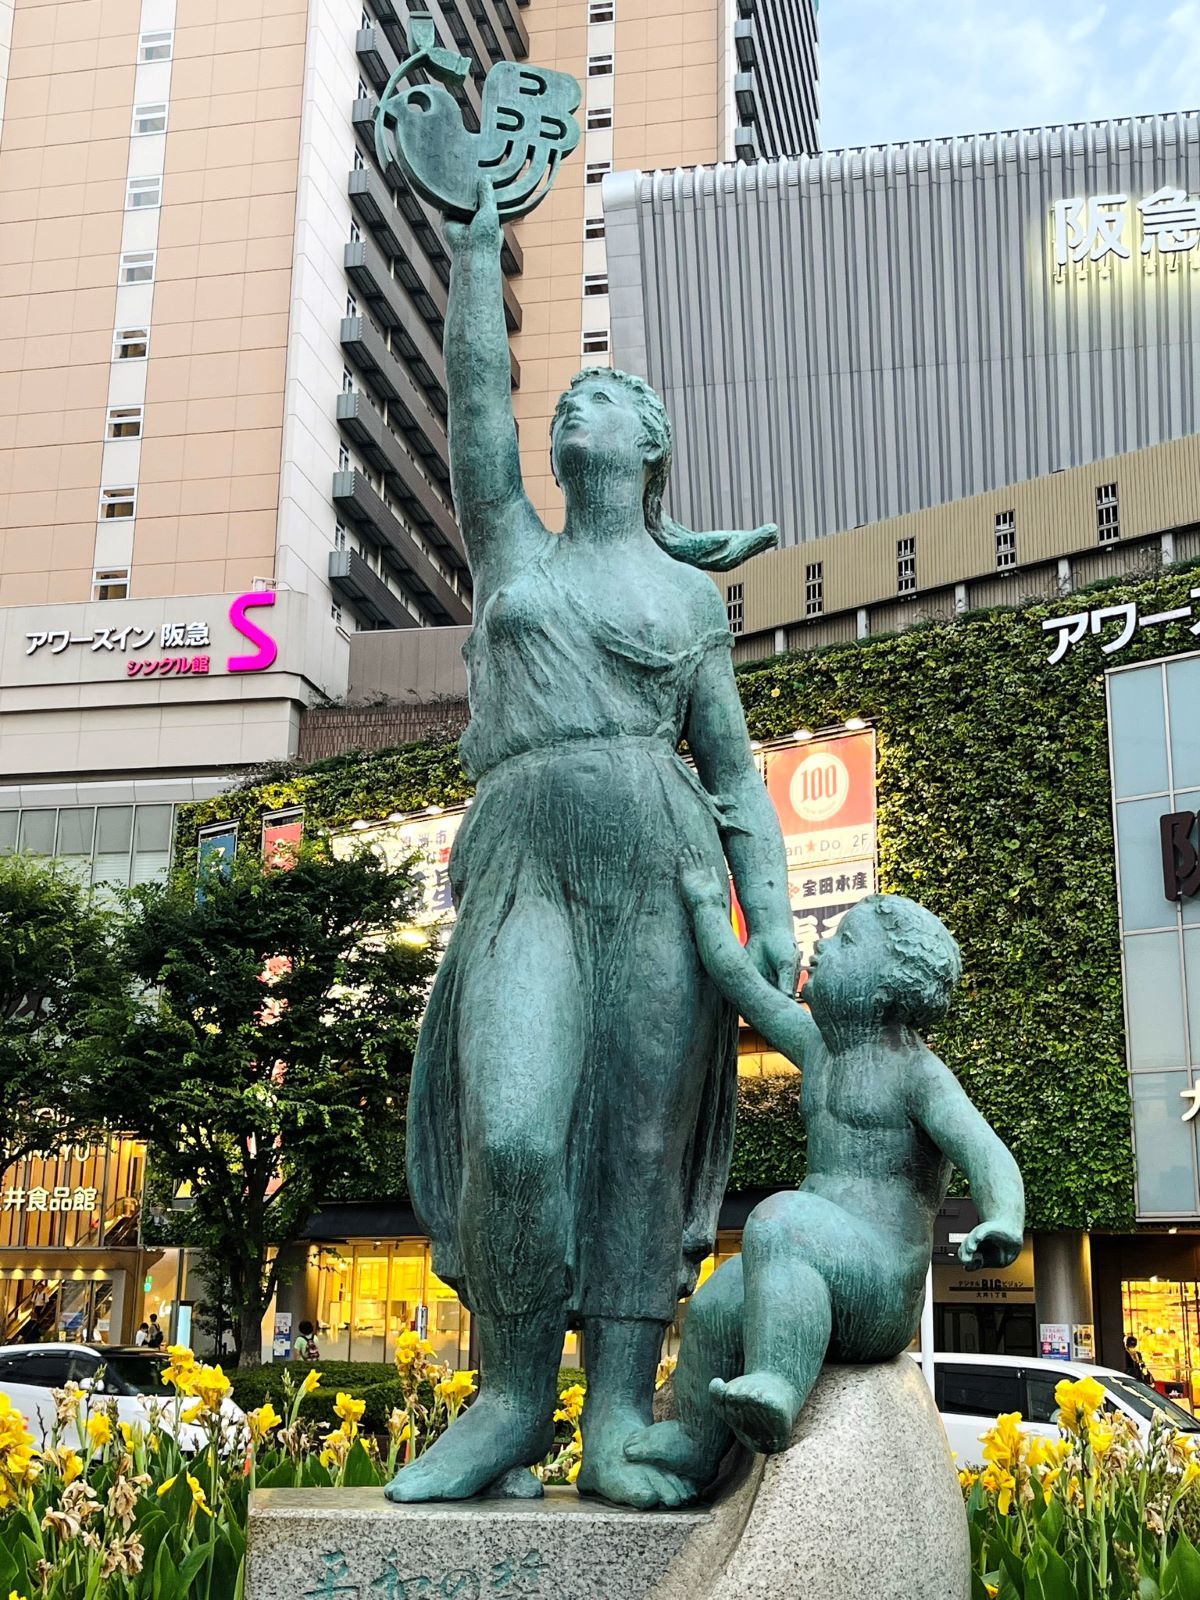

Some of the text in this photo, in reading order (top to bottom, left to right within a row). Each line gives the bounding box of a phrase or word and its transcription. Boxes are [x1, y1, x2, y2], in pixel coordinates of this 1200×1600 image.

[1053, 185, 1200, 266] 阪急
[25, 621, 211, 656] アワーズイン 阪急
[801, 764, 838, 804] 100
[852, 833, 869, 848] 2F
[802, 871, 868, 898] 宝田水産
[0, 1186, 98, 1212] 井食品館
